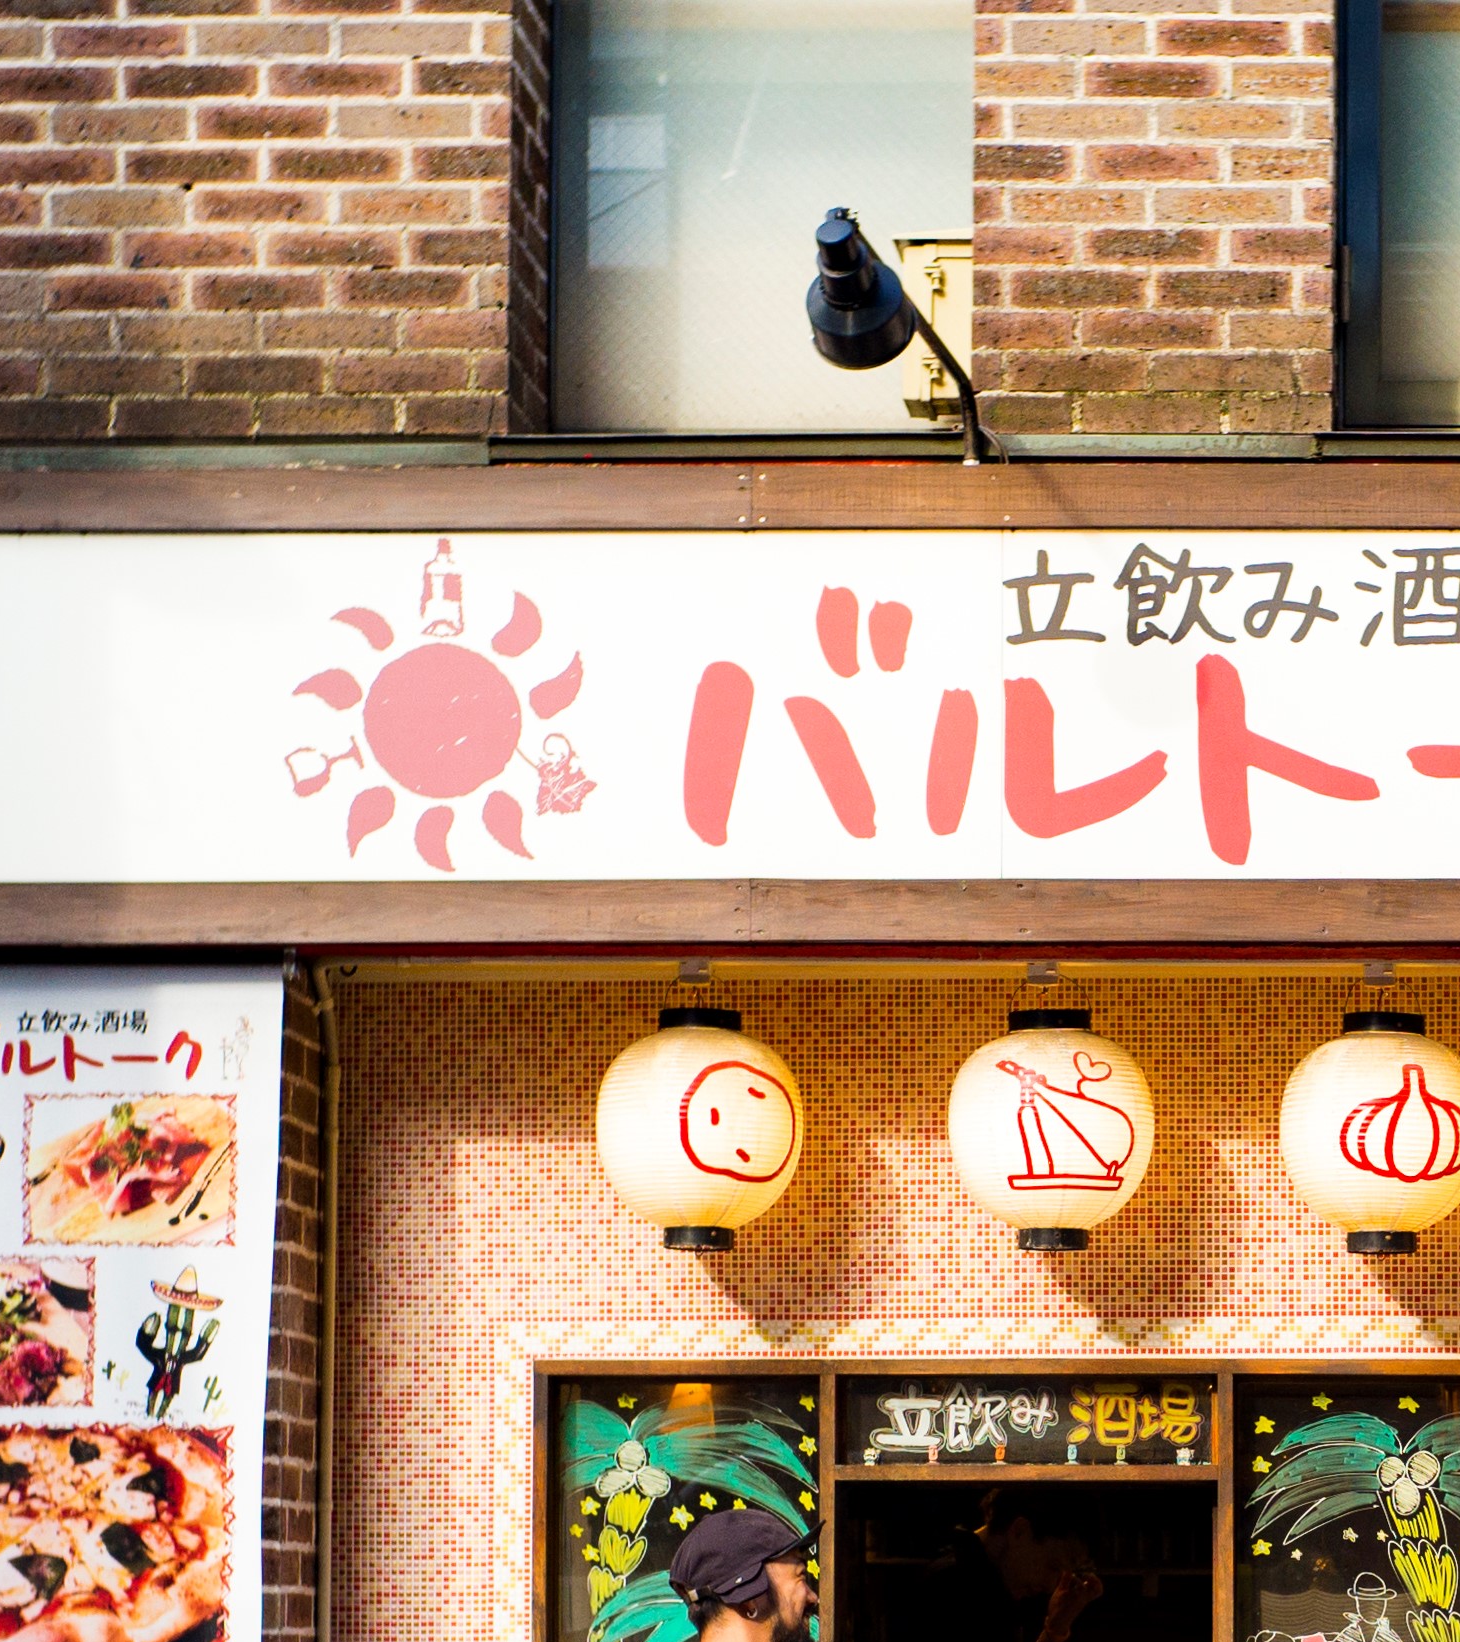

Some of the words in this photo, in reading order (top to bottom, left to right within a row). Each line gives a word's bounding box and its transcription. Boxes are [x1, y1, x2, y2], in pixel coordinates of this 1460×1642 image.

[16, 1009, 148, 1035] 立飲み酒場
[870, 1378, 1204, 1452] 立飲み酒場
